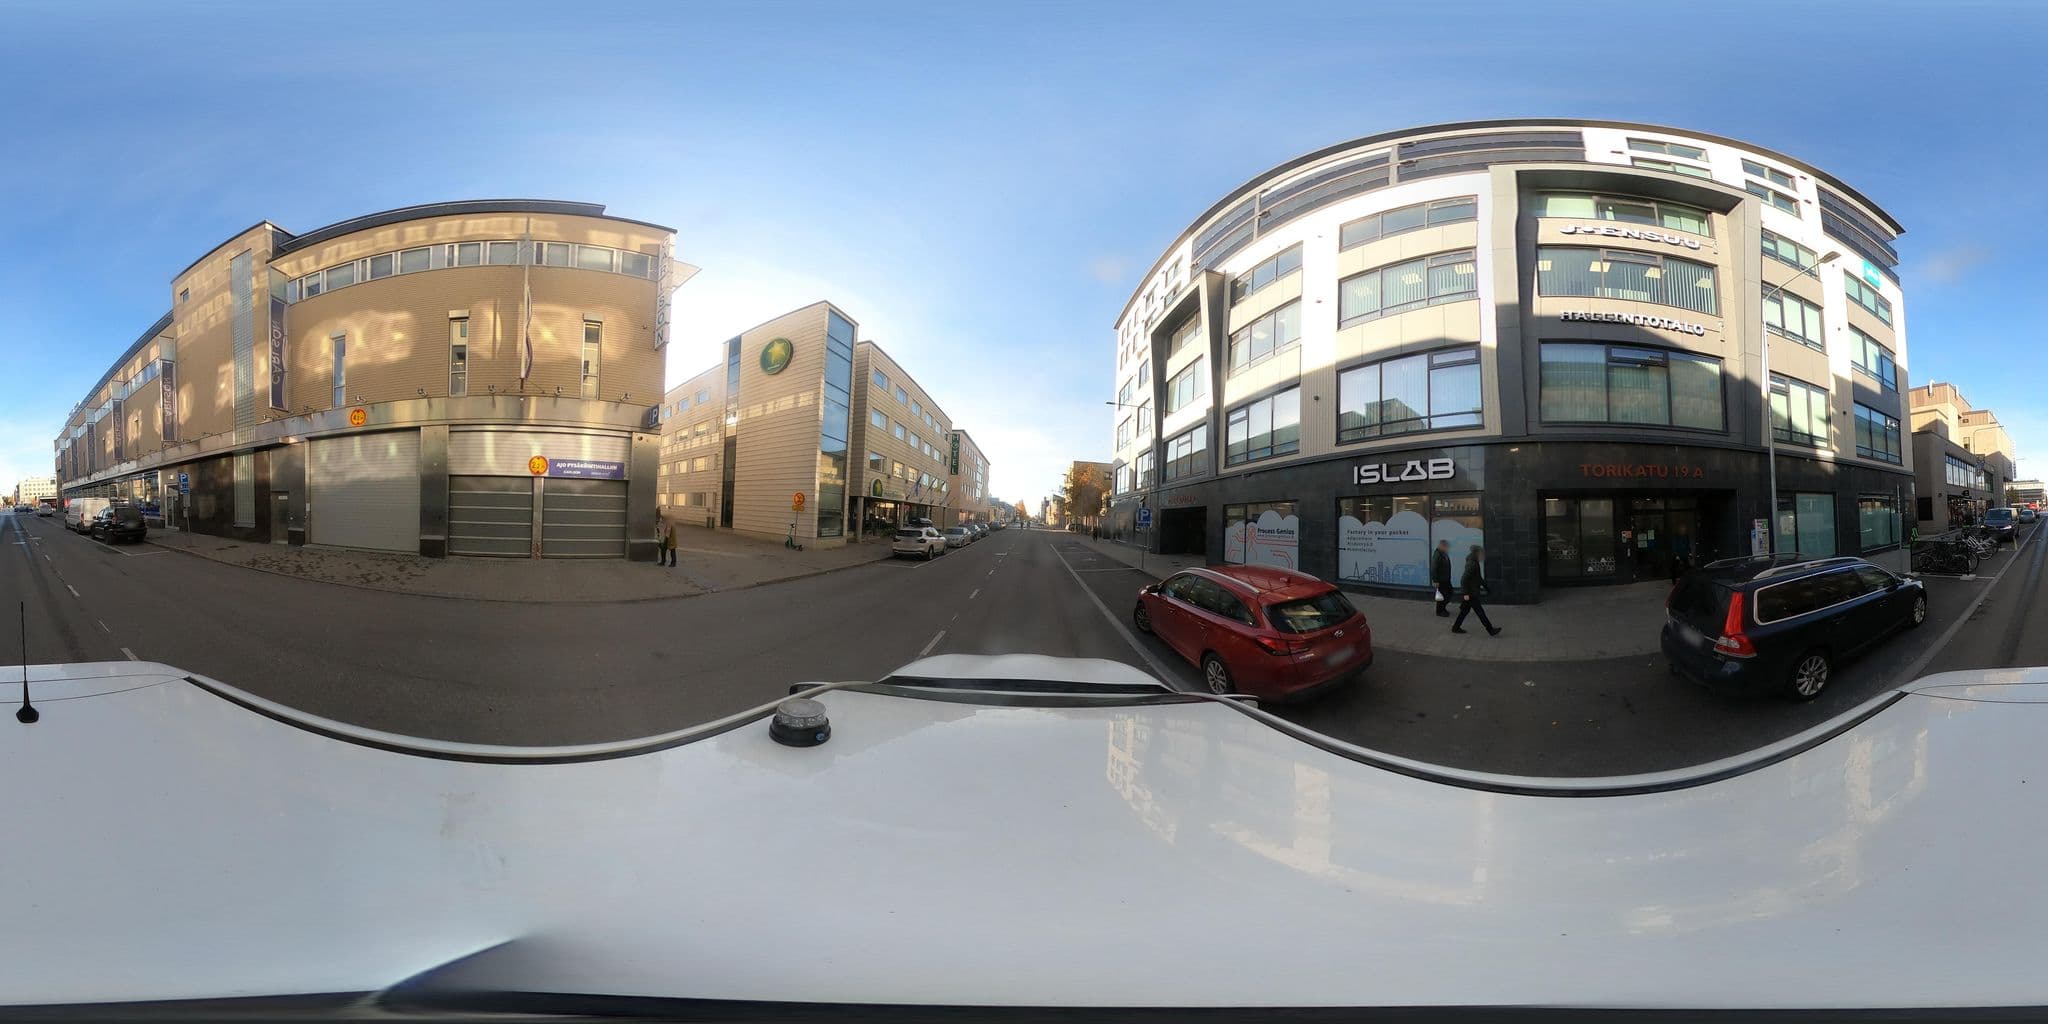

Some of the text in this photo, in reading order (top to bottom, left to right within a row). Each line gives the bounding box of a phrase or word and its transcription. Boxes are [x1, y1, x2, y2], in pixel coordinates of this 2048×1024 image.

[656, 238, 669, 344] CARLSON
[1560, 310, 1704, 336] HALLINTOTALO
[1353, 458, 1454, 485] ISLAB
[1579, 464, 1704, 478] TORIKATU 19 A
[1140, 509, 1149, 521] P
